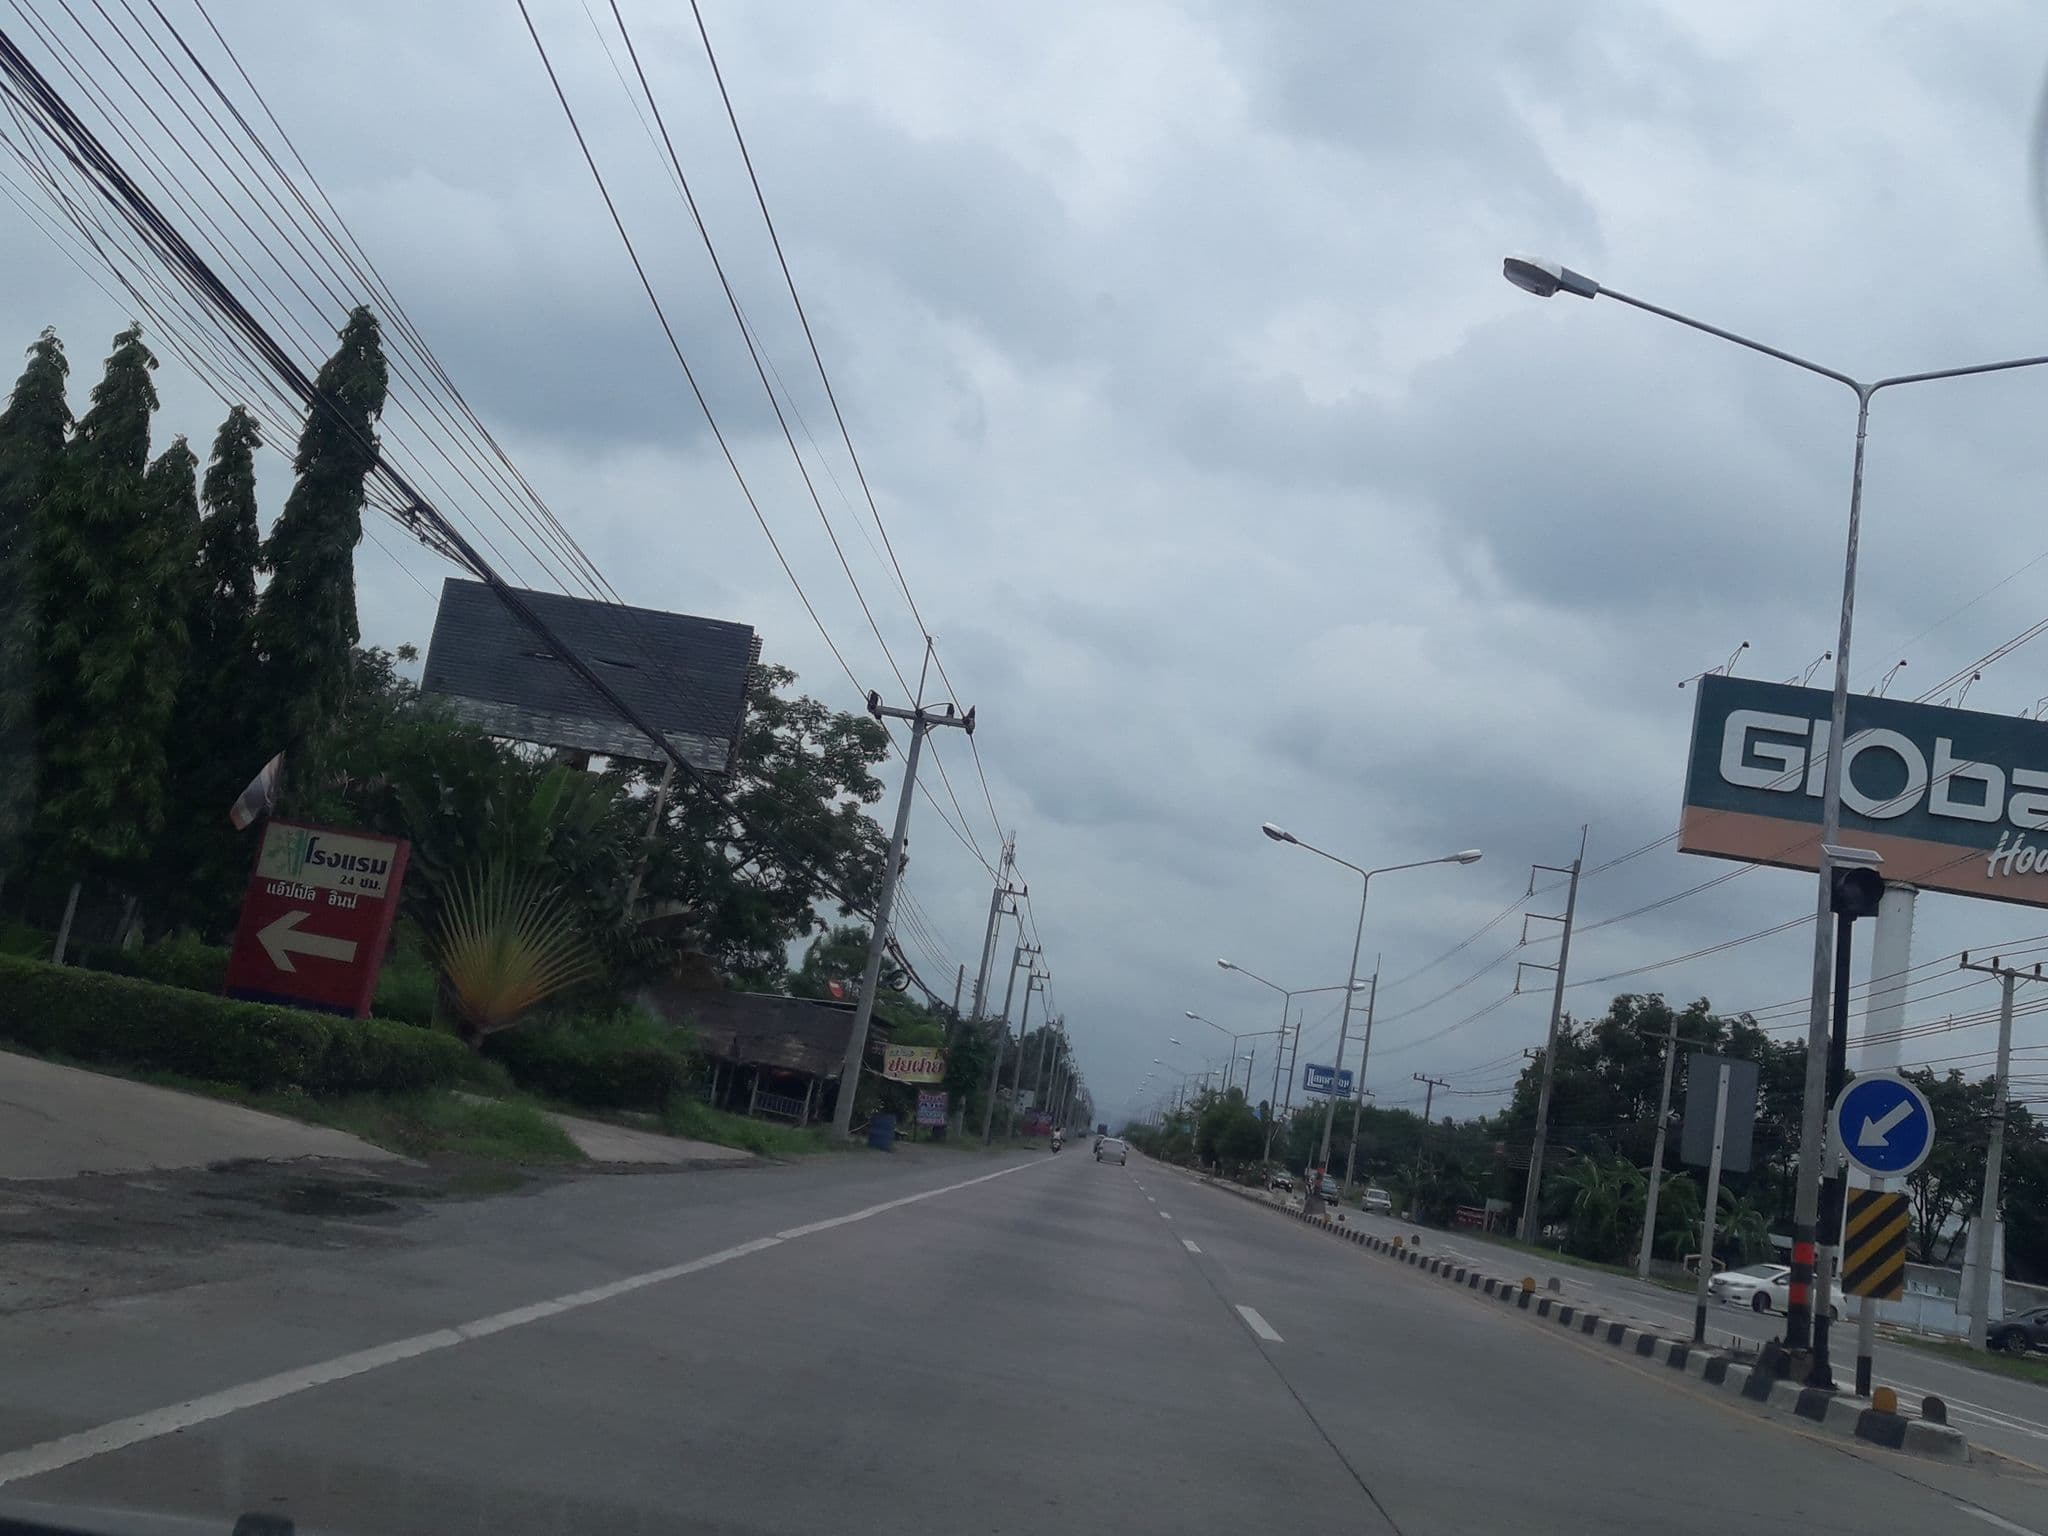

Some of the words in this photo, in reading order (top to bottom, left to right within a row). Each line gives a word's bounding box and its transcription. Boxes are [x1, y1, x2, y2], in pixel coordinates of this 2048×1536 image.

[304, 836, 388, 875] โรงแรม
[340, 875, 355, 886] 24
